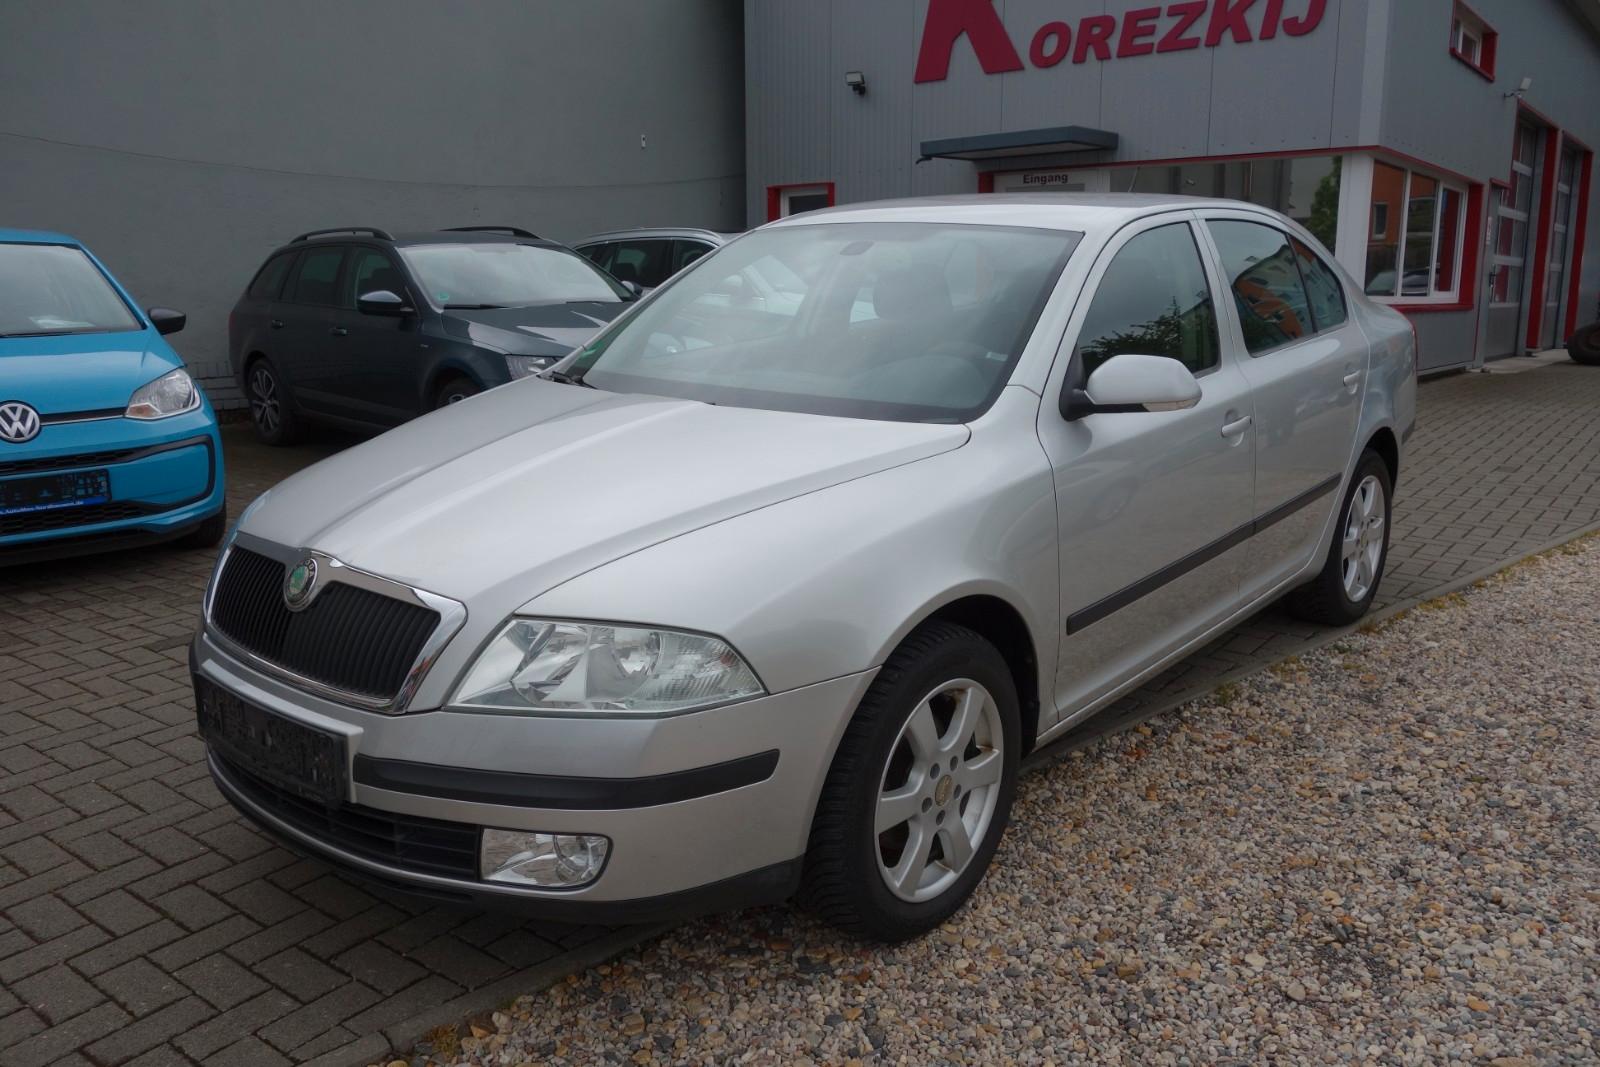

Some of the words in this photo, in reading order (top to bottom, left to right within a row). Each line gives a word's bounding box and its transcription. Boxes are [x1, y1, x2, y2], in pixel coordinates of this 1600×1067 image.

[914, 0, 1326, 84] KOREZKIJ
[1022, 173, 1069, 186] Eingang
[0, 404, 40, 441] VW
